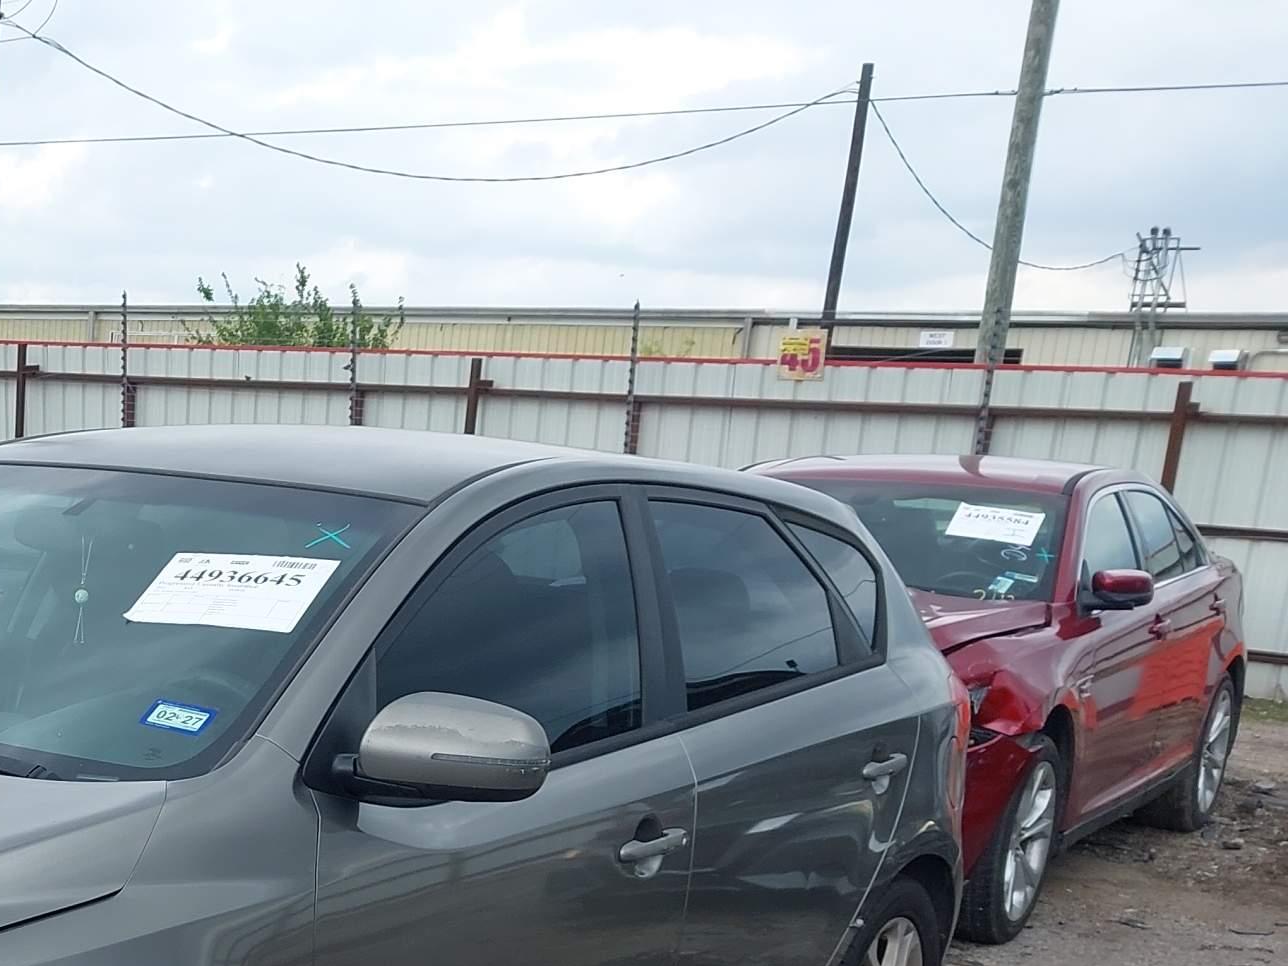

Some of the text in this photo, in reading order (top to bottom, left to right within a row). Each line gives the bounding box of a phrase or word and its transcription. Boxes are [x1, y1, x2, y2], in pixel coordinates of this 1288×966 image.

[174, 568, 306, 587] 44936645
[156, 710, 177, 721] 02
[181, 715, 204, 726] 27
